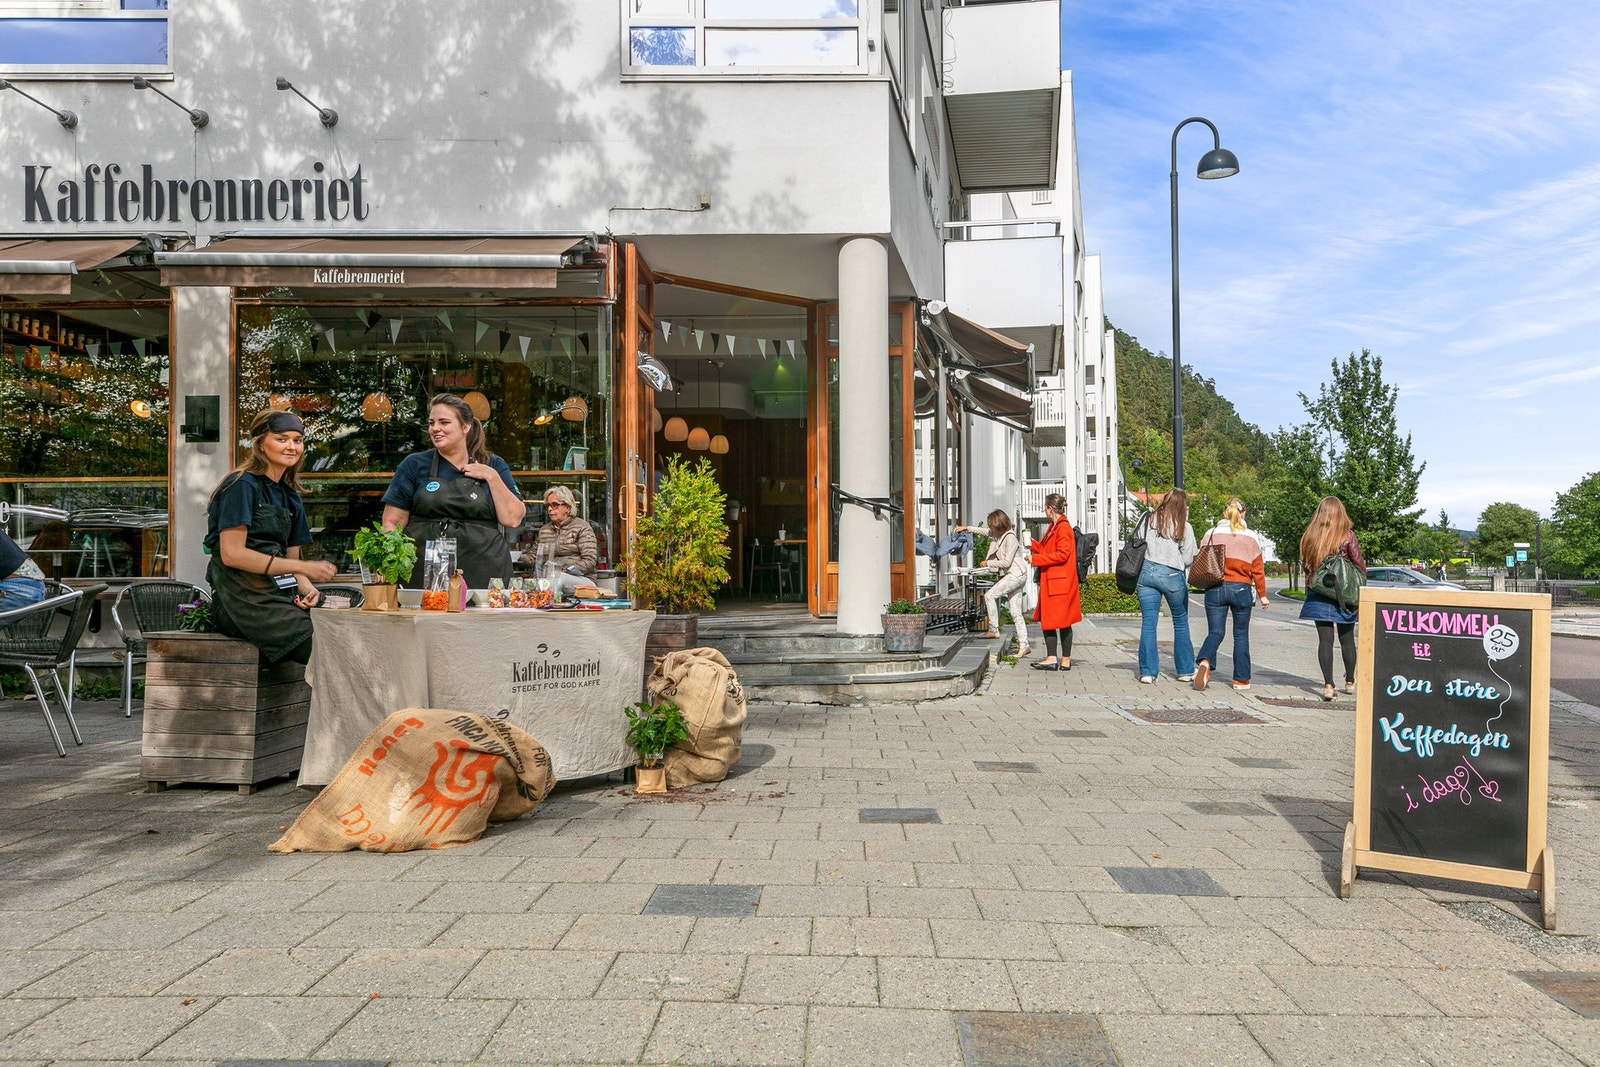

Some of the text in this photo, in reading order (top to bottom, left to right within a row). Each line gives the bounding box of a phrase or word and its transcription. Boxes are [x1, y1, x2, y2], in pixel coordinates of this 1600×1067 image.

[22, 161, 370, 222] Kaffebrenneriet
[313, 268, 405, 284] Kaffebrenneriet
[1381, 609, 1499, 637] VELKOMMEN
[1411, 642, 1432, 657] til
[1489, 628, 1516, 648] 25
[512, 659, 601, 683] Kaffebrenneriet
[511, 678, 601, 694] STEDET FOR GOD KAFFE
[1386, 674, 1501, 700] Den store
[444, 715, 489, 743] FINCA
[1378, 712, 1511, 758] Kaffedagen
[1400, 785, 1419, 812] i
